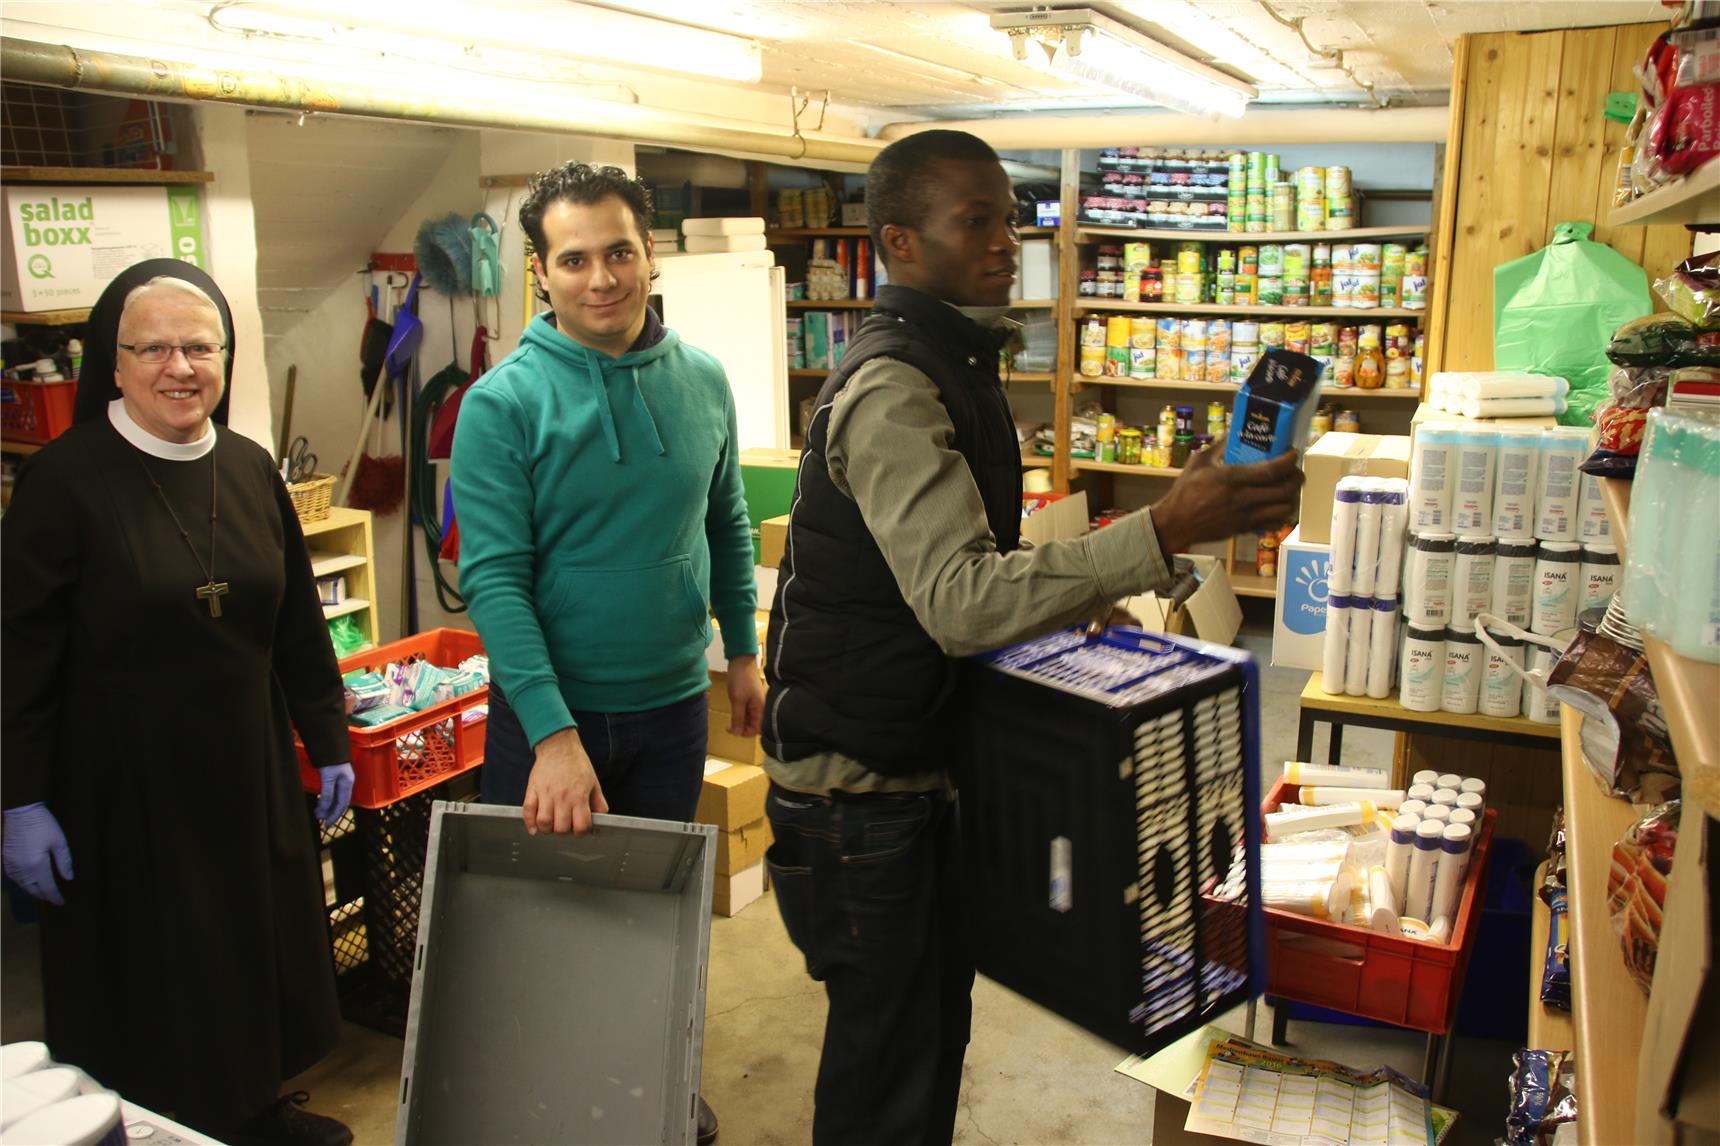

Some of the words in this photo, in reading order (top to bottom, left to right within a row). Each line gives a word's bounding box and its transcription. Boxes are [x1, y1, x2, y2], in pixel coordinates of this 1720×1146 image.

[1697, 87, 1715, 152] Parboiled
[20, 197, 94, 222] salad
[24, 223, 92, 247] boxx
[1544, 572, 1567, 580] ISANA
[1590, 575, 1613, 583] ISANA
[1300, 603, 1327, 616] Pape
[1411, 650, 1432, 658] ISANA
[1448, 652, 1470, 660] ISANA
